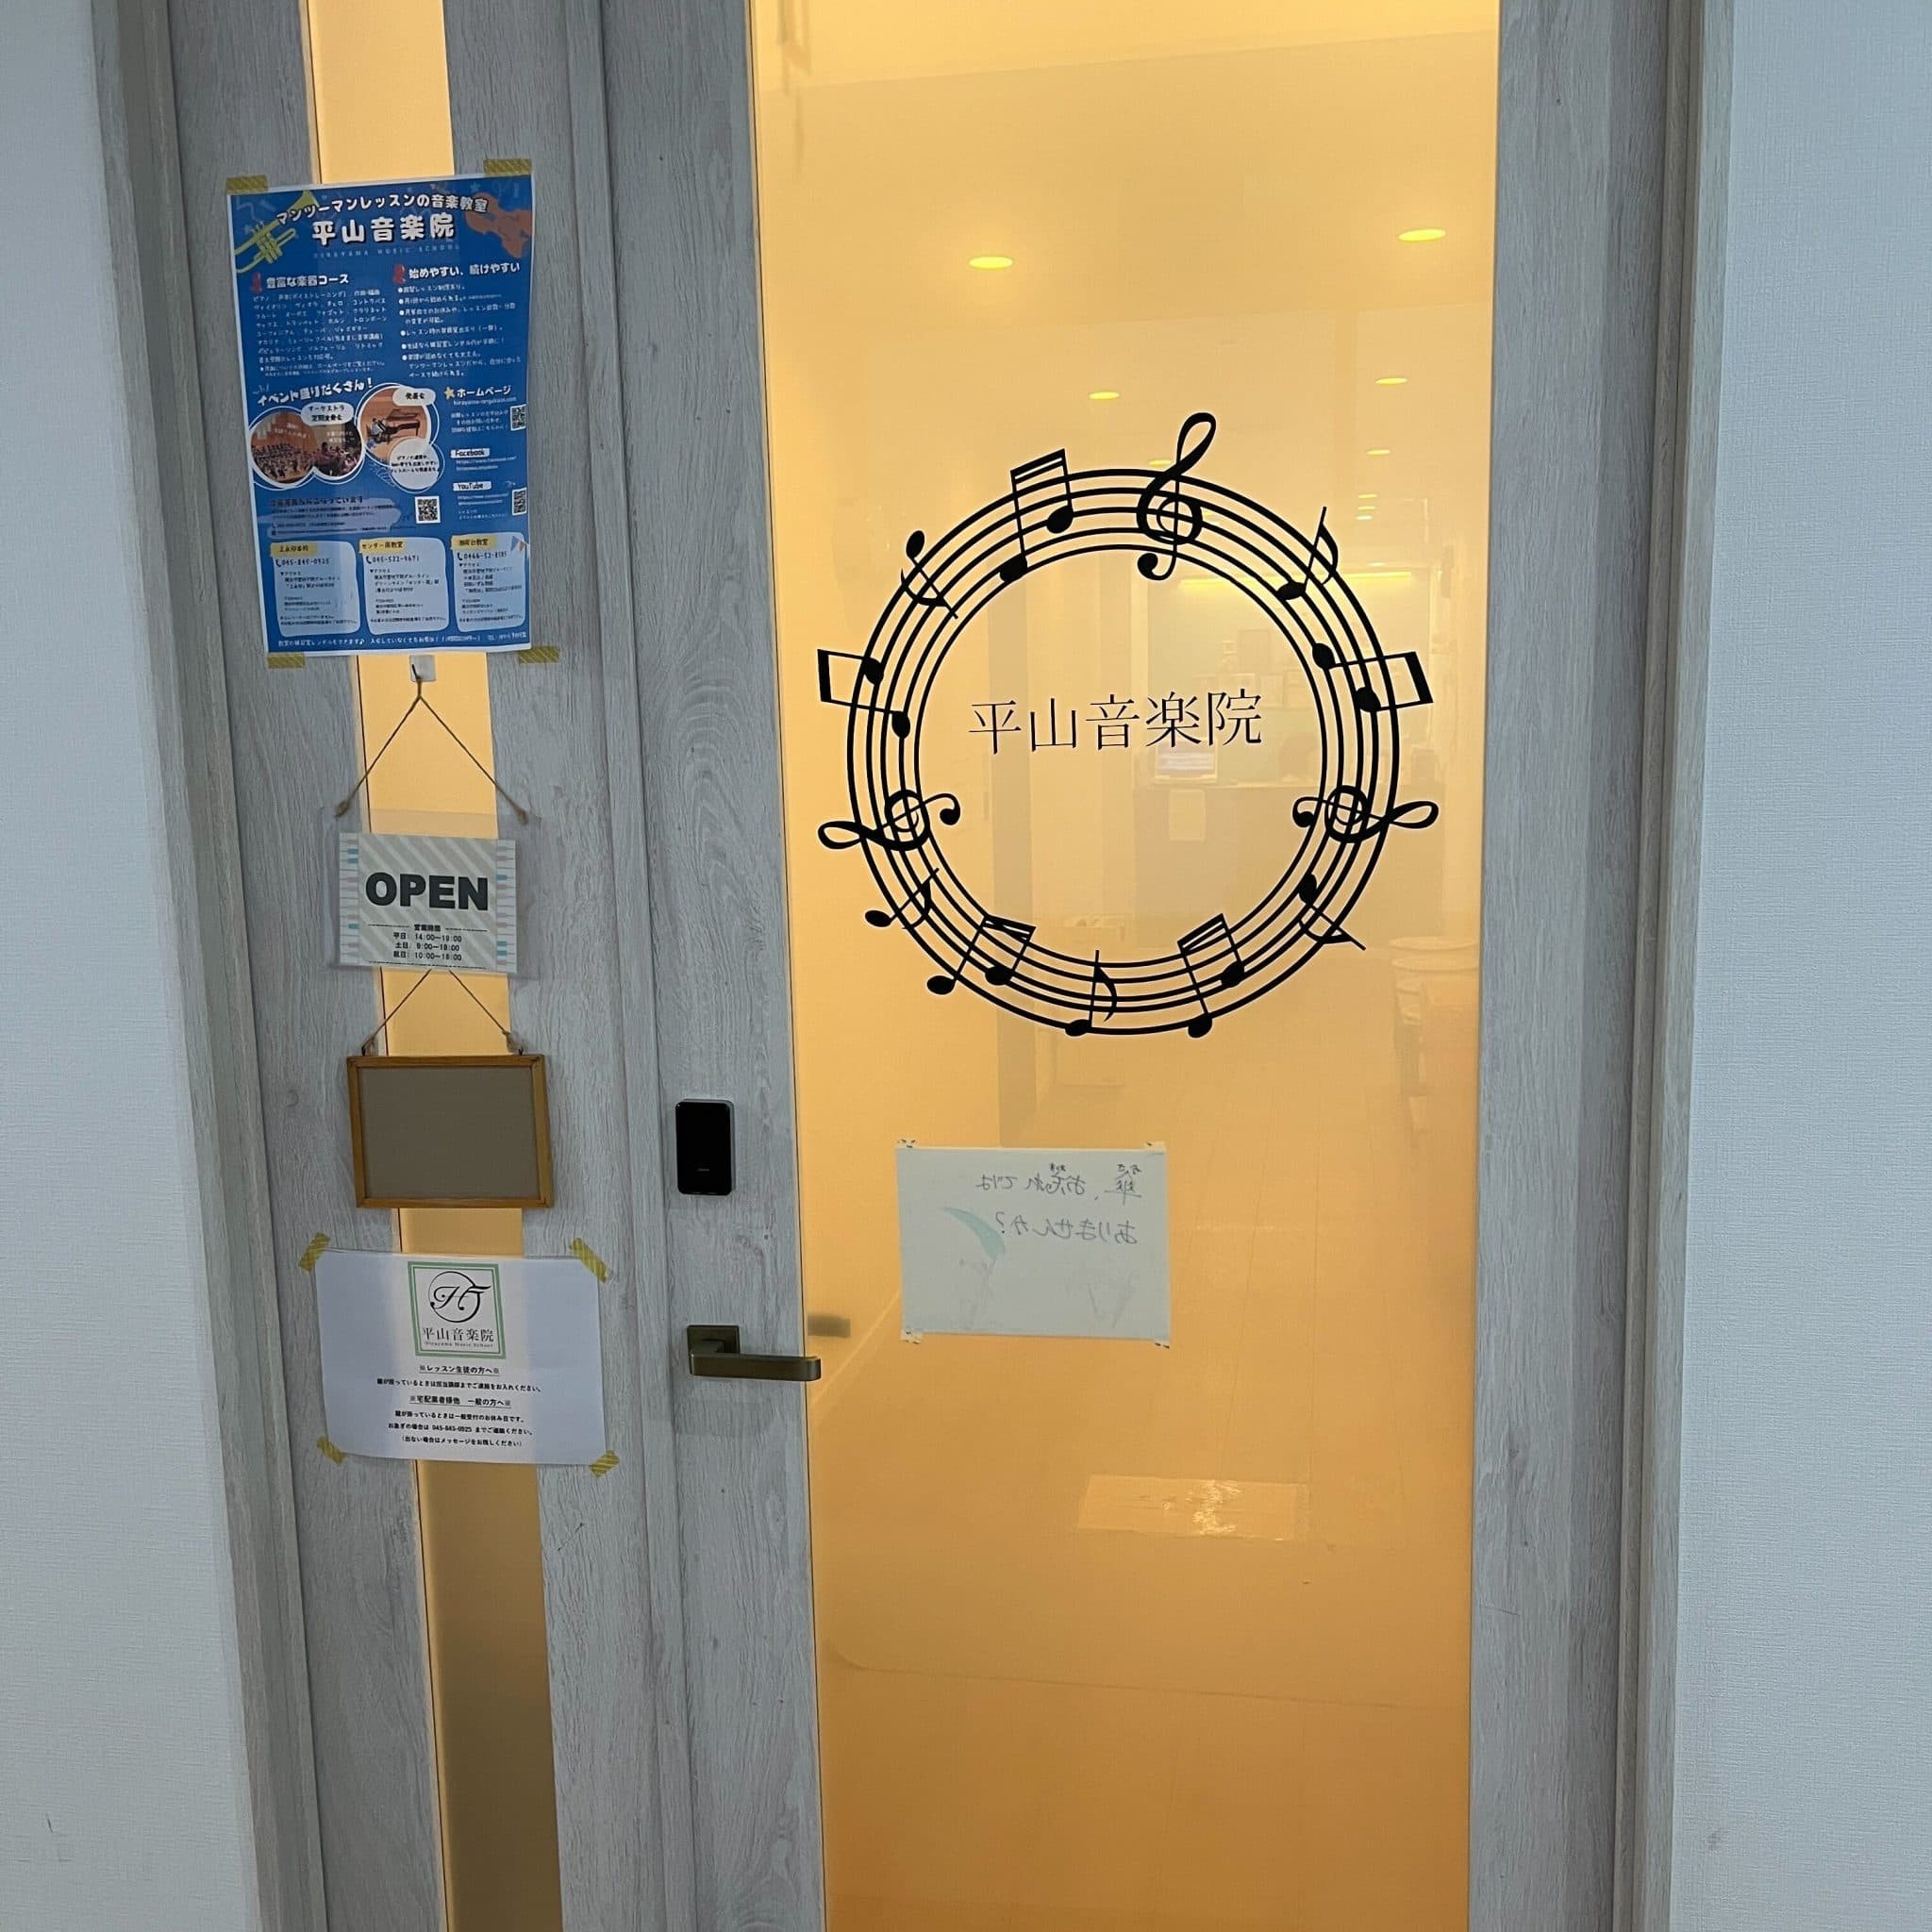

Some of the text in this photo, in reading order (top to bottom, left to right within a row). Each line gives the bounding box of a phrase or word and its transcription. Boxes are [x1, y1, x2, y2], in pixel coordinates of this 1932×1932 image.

[276, 193, 489, 225] マンツーマンレッスンの音楽教室
[312, 212, 456, 246] 平山音楽院
[457, 385, 511, 397] ホームページ
[968, 688, 1262, 756] 平山音楽院
[365, 872, 489, 911] OPEN
[423, 1327, 494, 1341] 平山音楽院
